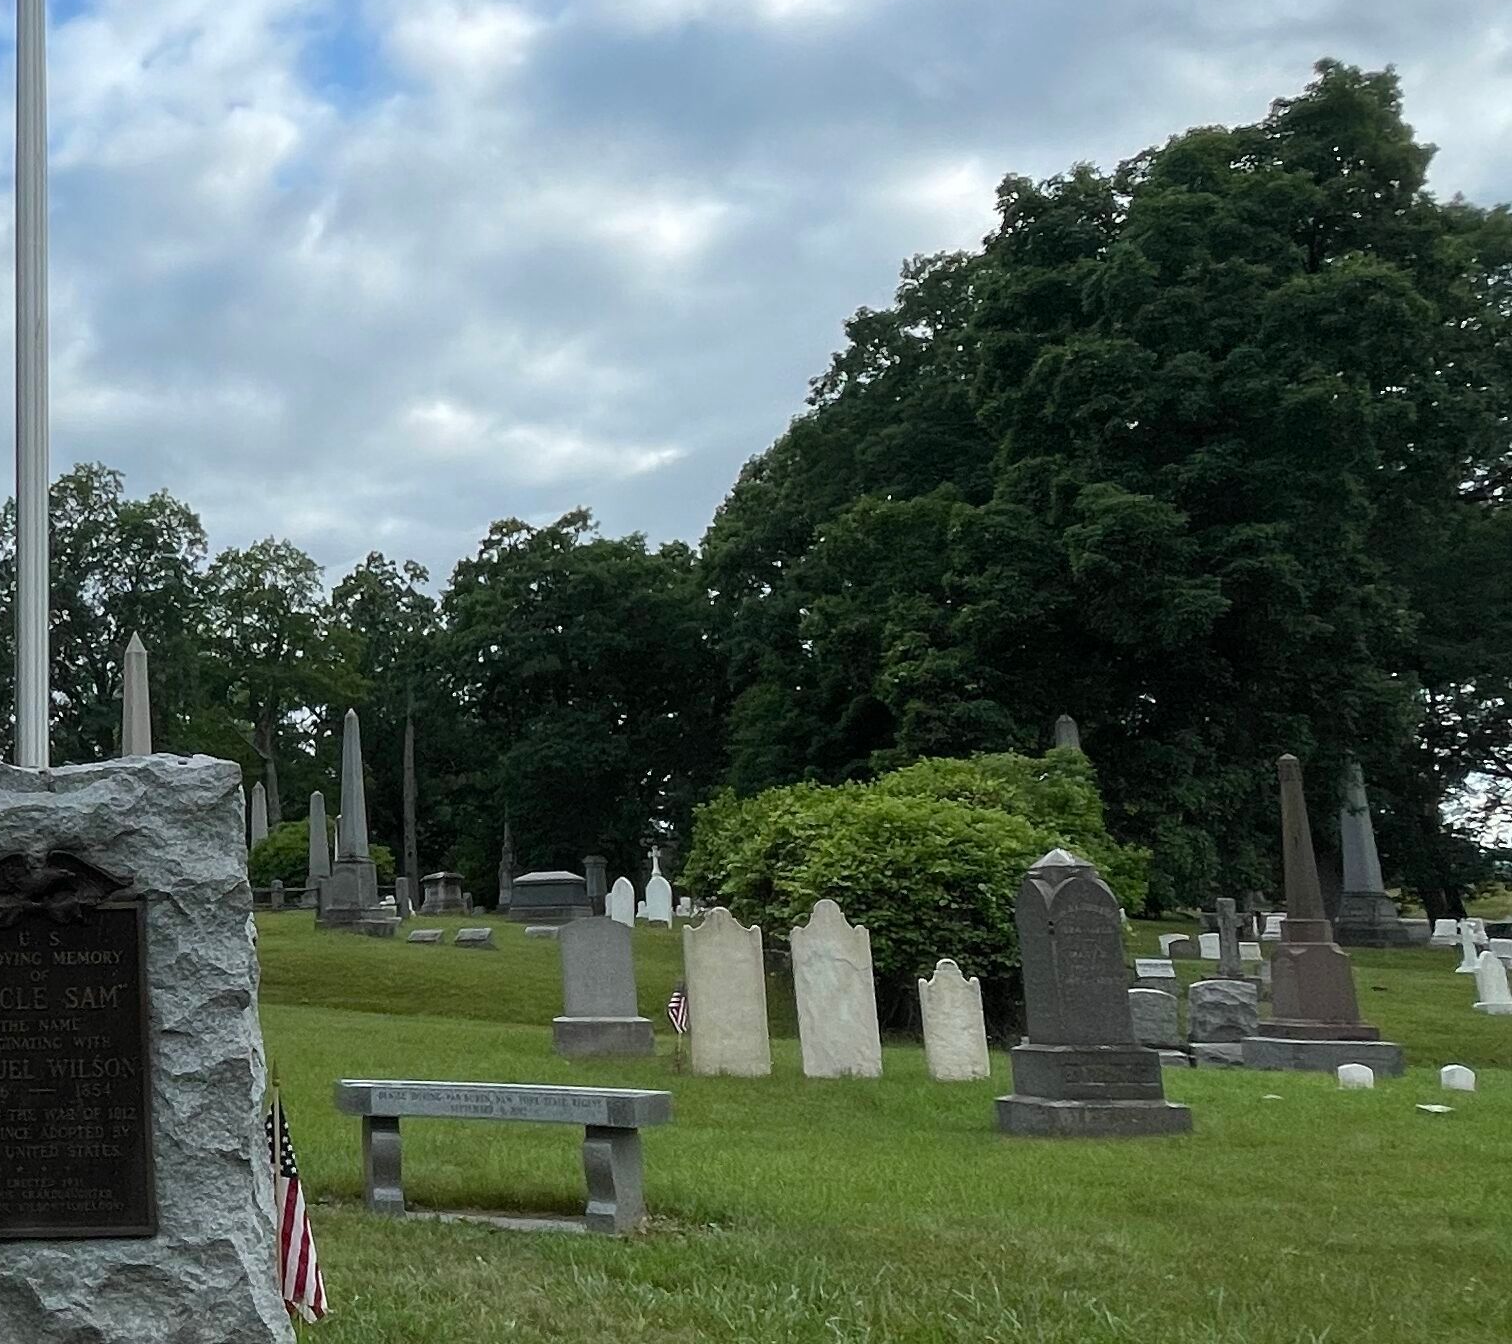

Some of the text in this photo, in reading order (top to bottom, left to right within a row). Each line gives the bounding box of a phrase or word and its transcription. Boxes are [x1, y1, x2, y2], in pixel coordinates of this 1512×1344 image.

[52, 949, 124, 965] MEMORY
[30, 969, 50, 982] OF
[0, 1017, 81, 1032] THE NAME
[73, 1035, 112, 1049] WITH
[46, 1057, 138, 1078] WILSON
[7, 1108, 37, 1122] THE
[44, 1107, 75, 1121] WAR
[82, 1107, 101, 1121] OF
[108, 1107, 138, 1120] 1812
[41, 1126, 104, 1139] ADOPTED
[4, 1145, 58, 1159] UNITED
[66, 1144, 122, 1157] STATES
